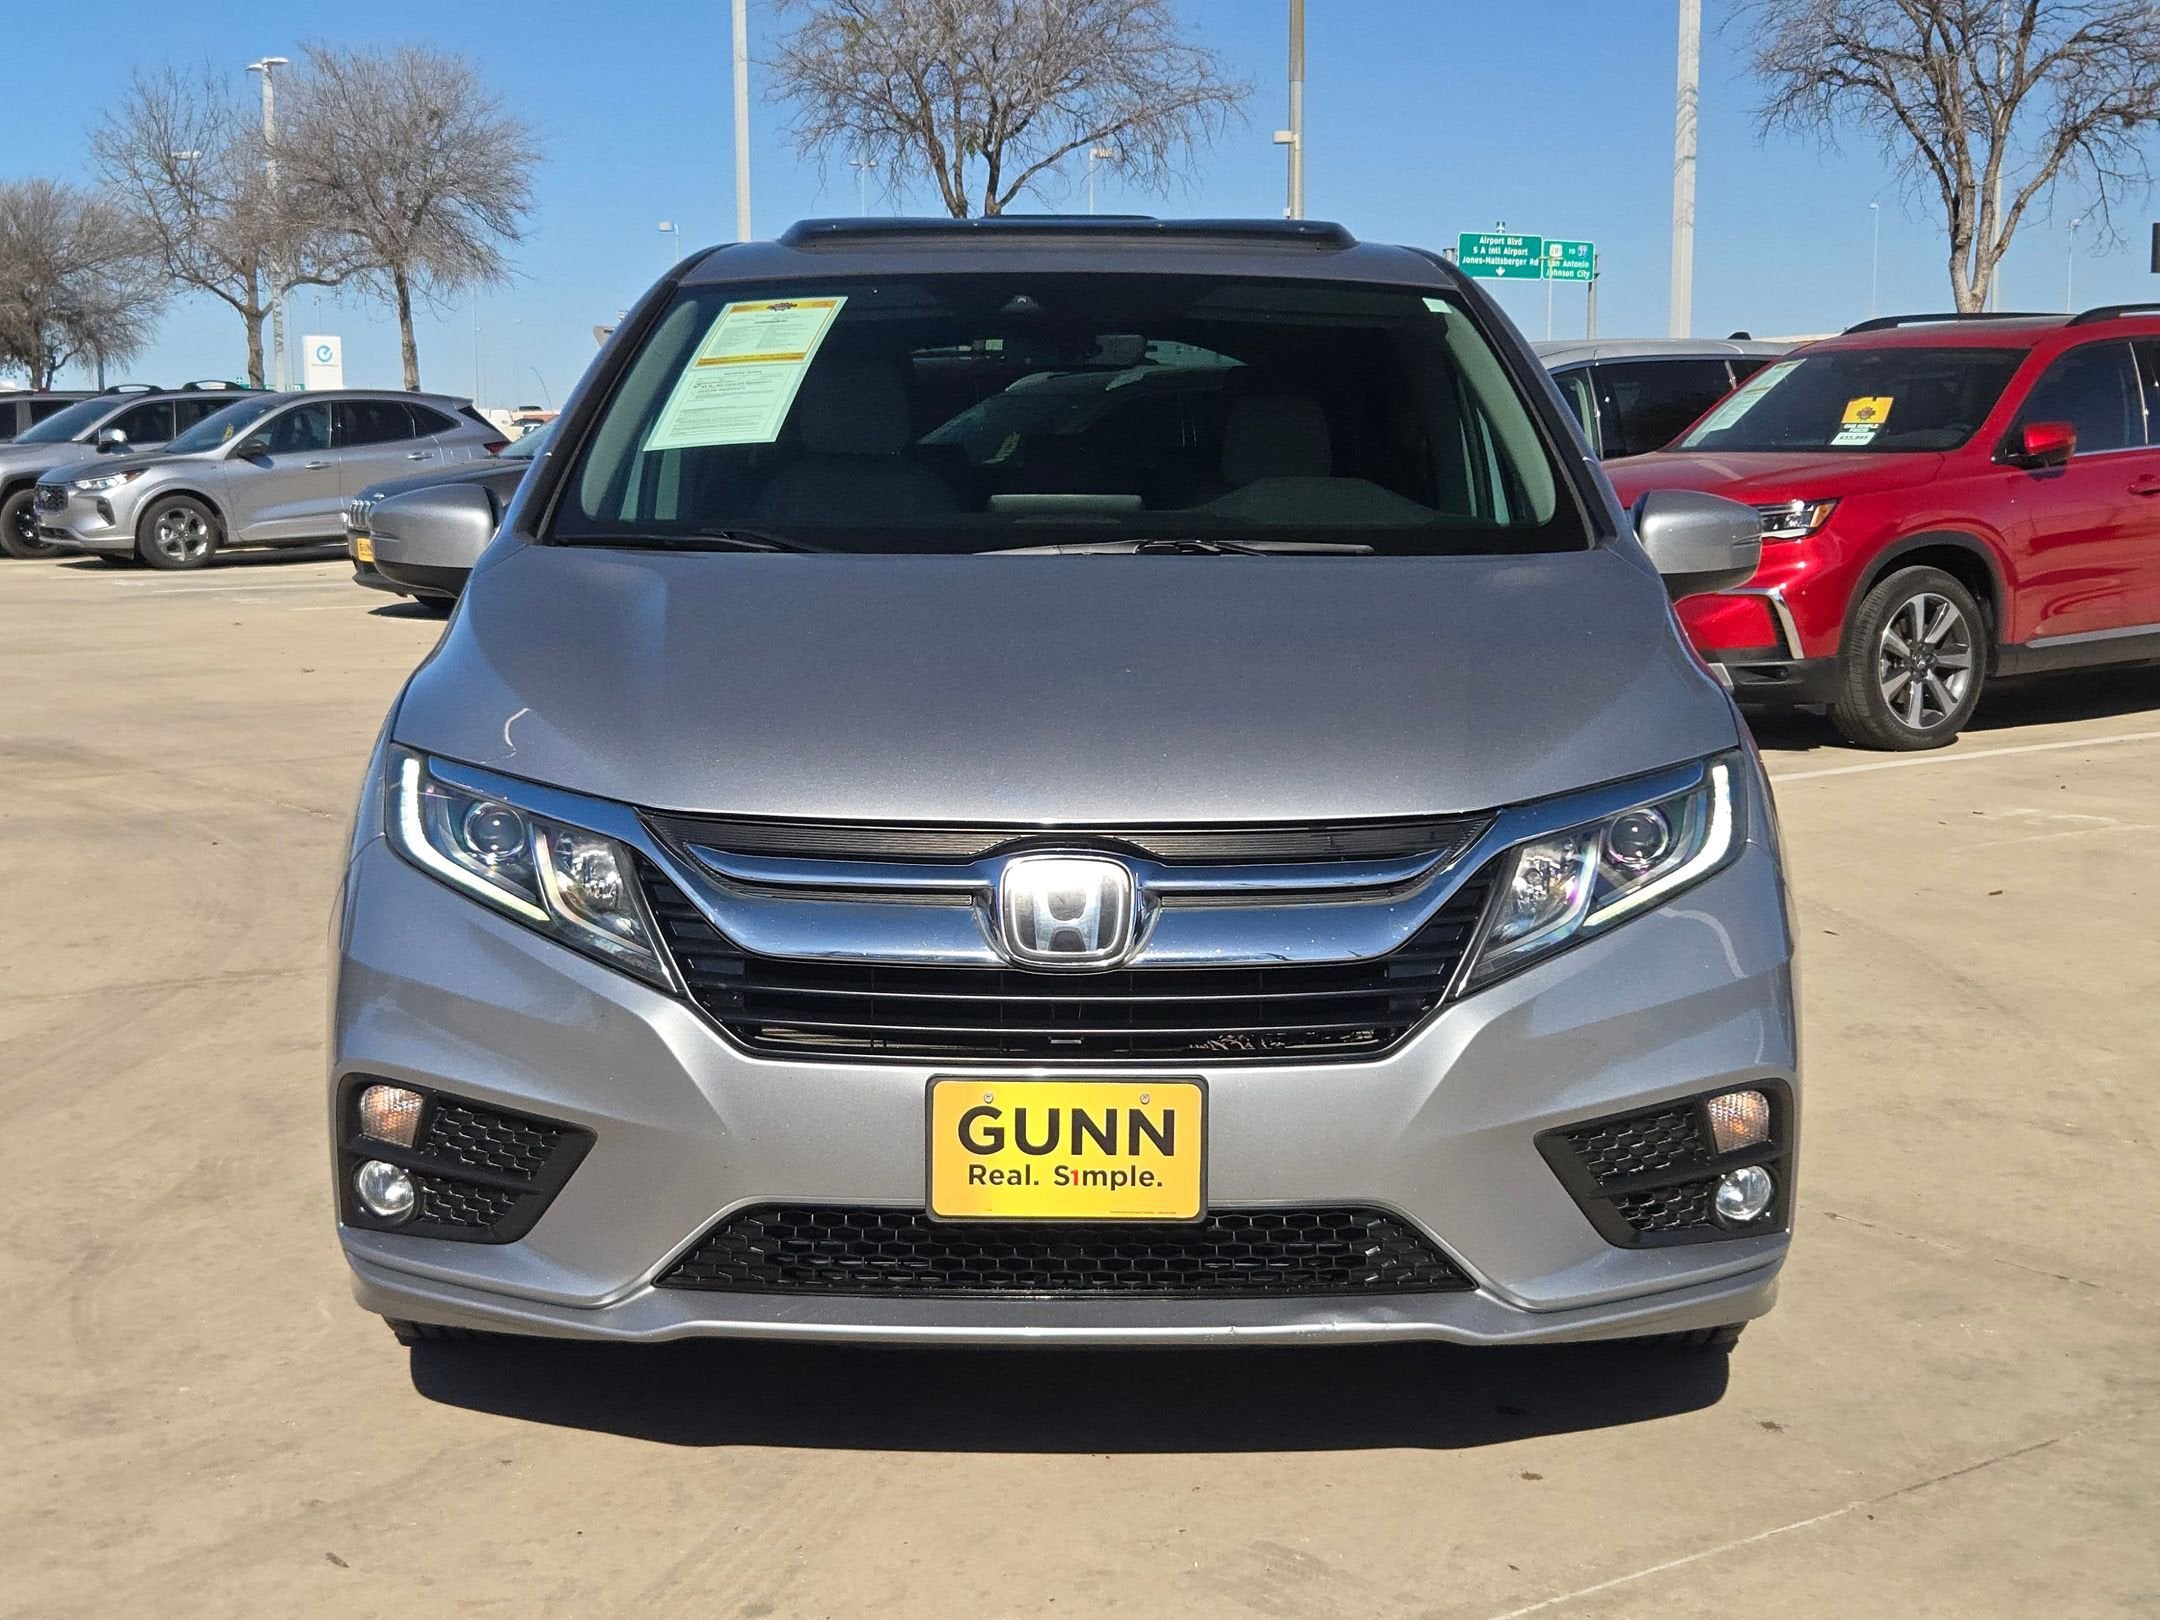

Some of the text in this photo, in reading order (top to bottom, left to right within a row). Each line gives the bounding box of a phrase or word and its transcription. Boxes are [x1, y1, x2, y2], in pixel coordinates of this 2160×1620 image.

[1480, 236, 1523, 246] Airport Blvd
[1473, 246, 1478, 254] S
[1480, 246, 1486, 254] A
[1503, 247, 1528, 257] Airport
[1529, 257, 1539, 266] Rd
[1562, 259, 1589, 268] Antonio
[1576, 269, 1590, 280] City
[957, 1105, 1175, 1156] GUNN
[969, 1164, 1039, 1186] Real.
